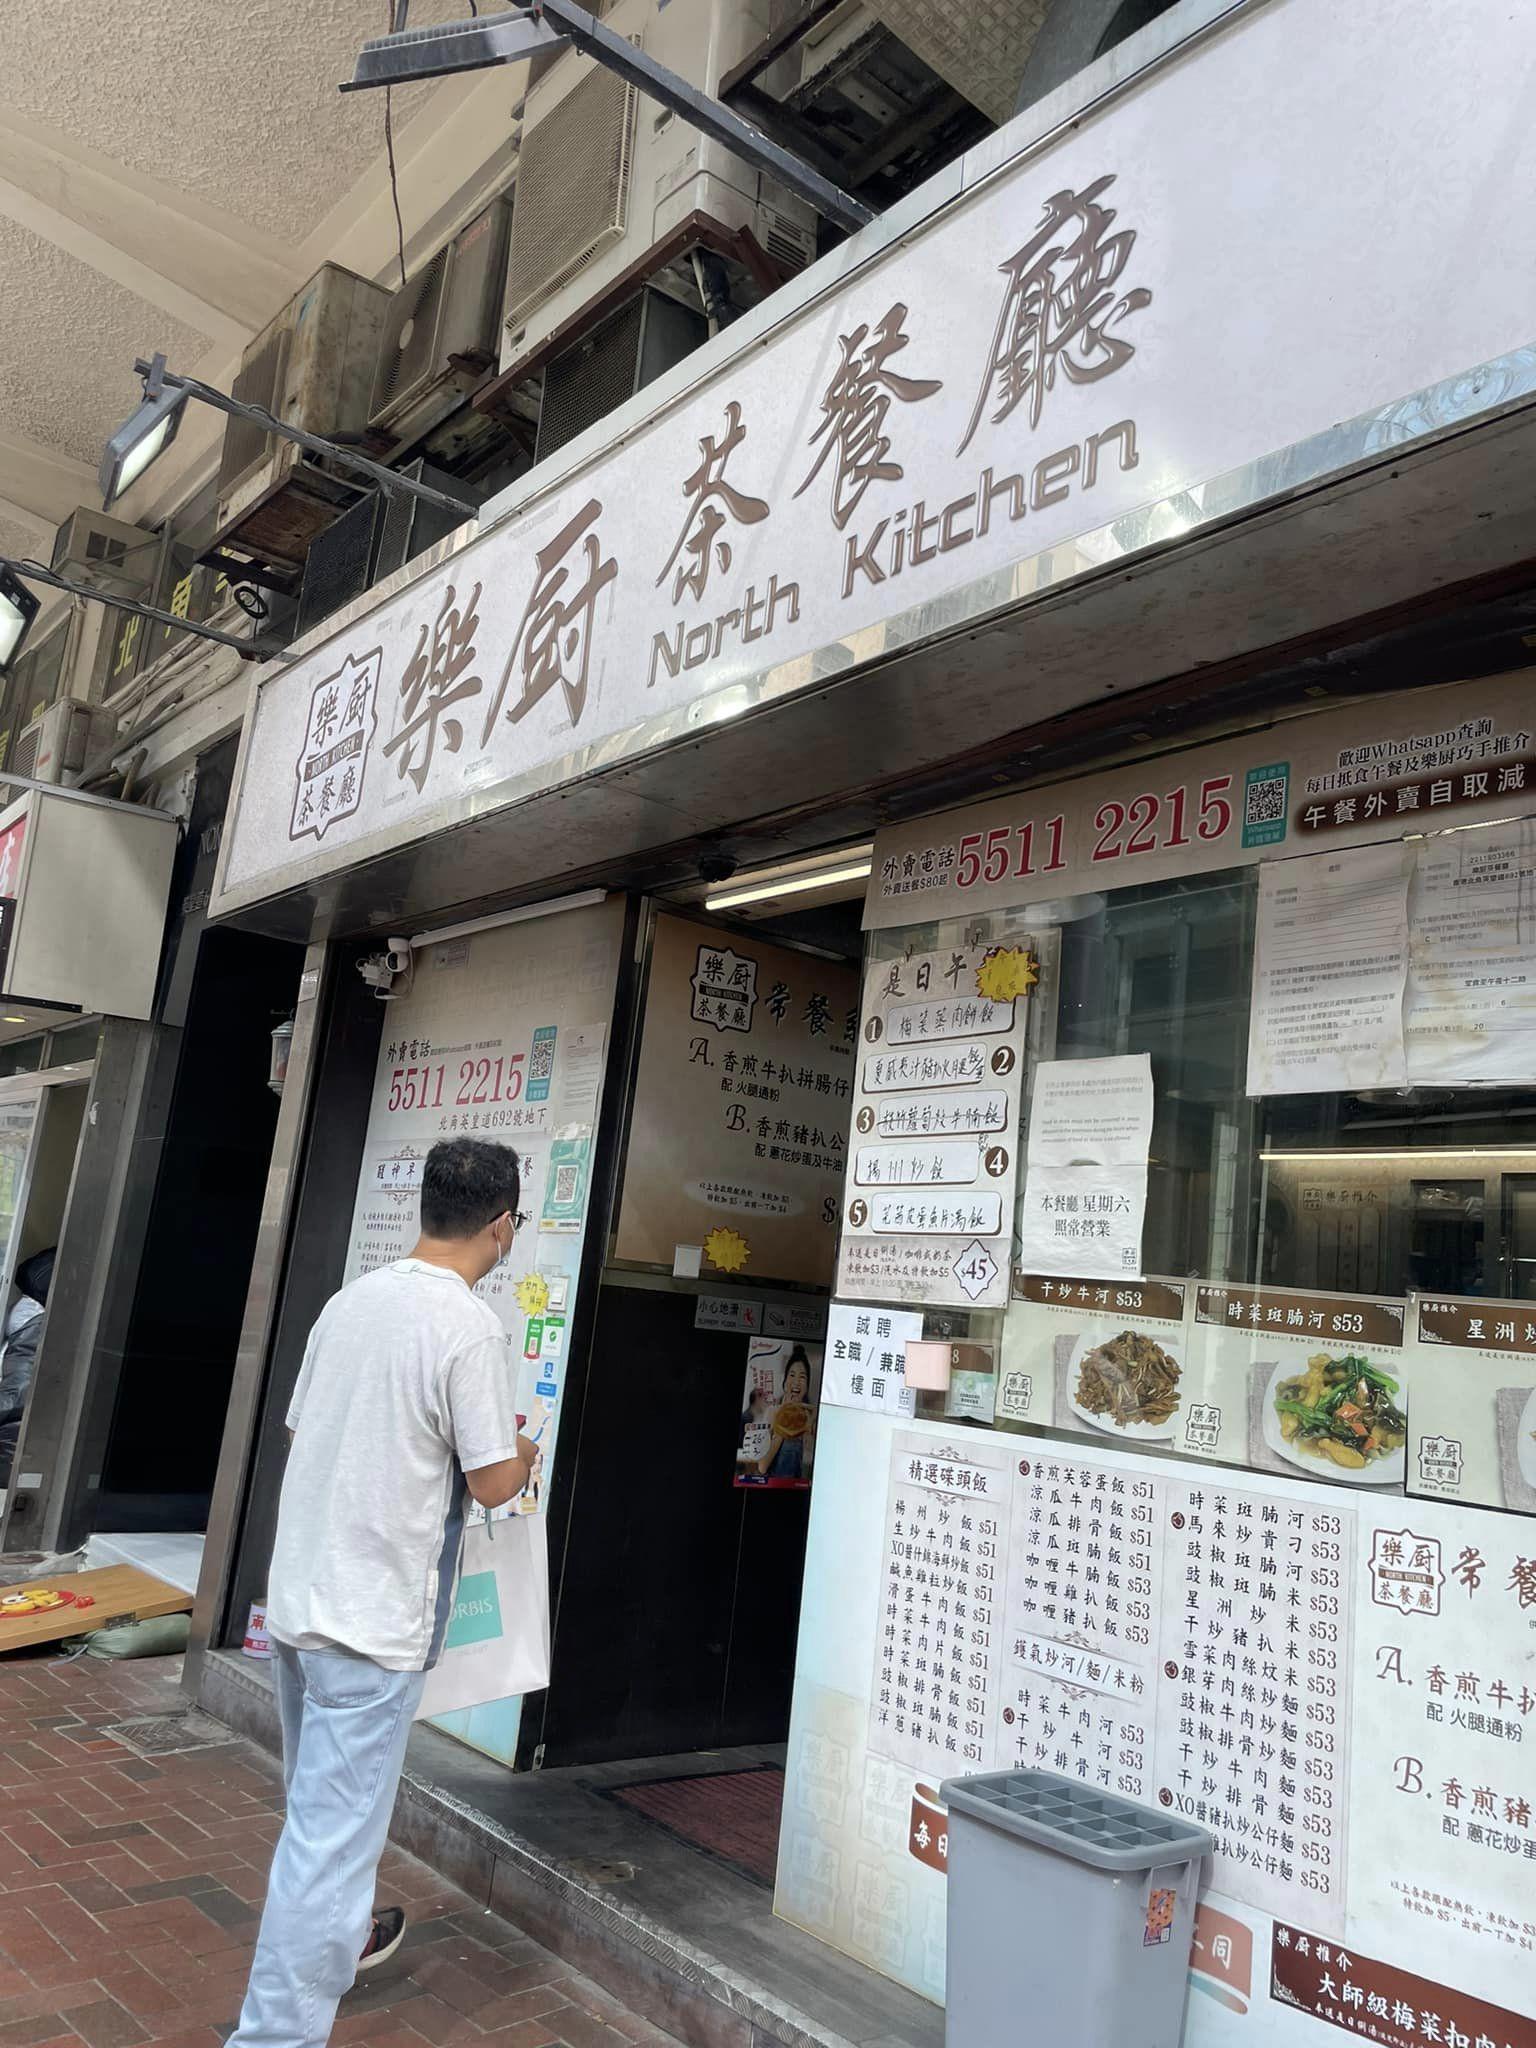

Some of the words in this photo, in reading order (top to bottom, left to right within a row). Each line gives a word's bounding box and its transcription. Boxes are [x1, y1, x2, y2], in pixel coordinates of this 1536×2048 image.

[648, 574, 800, 688] North
[841, 418, 1140, 600] Kitchen
[1303, 763, 1526, 830] 午餐外賣自取減
[881, 847, 954, 881] 外賣電話
[956, 814, 1068, 888] 5511
[1092, 775, 1233, 863] 2215
[702, 954, 752, 993] 樂厨
[882, 949, 987, 1000] 是日午
[695, 997, 747, 1028] 茶餐廳
[387, 1039, 431, 1063] 外賣電話
[689, 1037, 715, 1067] A.
[388, 1063, 446, 1112] 5511
[455, 1053, 526, 1106] 2215
[725, 1103, 751, 1134] B.
[1041, 1193, 1079, 1213] 本餐廳
[1083, 1193, 1130, 1213] 星期六
[1054, 1218, 1112, 1238] 照常營業
[961, 1257, 989, 1281] $45
[1041, 1281, 1110, 1306] 干炒牛河
[1116, 1290, 1142, 1309] $53
[856, 1315, 892, 1339] 誠聘
[1227, 1301, 1327, 1331] 時菜斑腩河
[1332, 1313, 1364, 1336] $53
[850, 1373, 886, 1400] 樓面
[908, 1459, 988, 1493] 精選碟頭飯
[1033, 1462, 1125, 1495] 香煎芙蓉蛋飯
[1132, 1481, 1155, 1500] $51
[1030, 1484, 1124, 1518] 涼瓜牛肉飯
[1131, 1505, 1154, 1524] $51
[1189, 1491, 1305, 1530] 時菜斑腩河
[1312, 1514, 1341, 1536] $53
[893, 1520, 971, 1553] 生炒牛肉飯
[977, 1541, 996, 1559] $51
[979, 1519, 997, 1537] $51
[1029, 1506, 1123, 1542] 涼瓜排骨飯
[1130, 1528, 1153, 1548] $51
[1188, 1514, 1302, 1554] 馬來炒貴刁
[1311, 1541, 1340, 1562] $53
[1028, 1528, 1122, 1566] 涼瓜斑腩飯
[1129, 1552, 1152, 1572] $51
[1186, 1541, 1304, 1582] 豉椒斑腩河
[1310, 1567, 1340, 1589] $53
[1379, 1537, 1435, 1574] 樂厨
[976, 1563, 995, 1581] $51
[1127, 1576, 1152, 1596] $53
[1185, 1565, 1301, 1607] 豉椒斑腩米
[1309, 1594, 1339, 1616] $53
[888, 1581, 967, 1618] 滑蛋牛肉飯
[972, 1607, 992, 1626] $51
[974, 1585, 993, 1603] $51
[1126, 1600, 1151, 1620] $53
[1378, 1581, 1434, 1611] 茶餐廳
[886, 1602, 965, 1641] 時菜牛肉飯
[971, 1630, 991, 1648] $51
[1125, 1625, 1149, 1646] $53
[1185, 1590, 1301, 1634] 星洲炒米
[1308, 1621, 1338, 1643] $53
[885, 1623, 964, 1663] 時菜肉片飯
[969, 1652, 988, 1671] $51
[1308, 1648, 1337, 1670] $53
[1375, 1645, 1413, 1687] A.
[883, 1645, 962, 1685] 時菜斑腩飯
[968, 1674, 987, 1693] $51
[1183, 1639, 1299, 1687] 雪菜肉絲炆米
[1307, 1674, 1336, 1698] $53
[881, 1666, 961, 1707] 豉椒排骨飯
[966, 1697, 986, 1716] $51
[879, 1688, 959, 1731] 豉椒斑腩飯
[964, 1720, 985, 1740] $51
[1018, 1688, 1114, 1736] 時菜牛肉河
[1120, 1724, 1144, 1745] $53
[1180, 1691, 1299, 1743] 豉椒牛肉炒麵
[1305, 1730, 1335, 1754] $53
[1306, 1702, 1336, 1726] $53
[1426, 1701, 1444, 1723] 配
[1450, 1707, 1523, 1743] 火腿通粉
[963, 1743, 983, 1763] $51
[1016, 1712, 1113, 1761] 干炒牛河
[1119, 1749, 1143, 1771] $53
[1178, 1717, 1298, 1770] 豉椒排骨炒麵
[1304, 1757, 1334, 1782] $53
[1015, 1736, 1112, 1787] 干炒排骨河
[1118, 1773, 1142, 1797] $53
[1178, 1742, 1297, 1798] 干炒牛肉麵
[1303, 1786, 1333, 1810] $53
[1177, 1768, 1296, 1826] 干炒排骨麵
[1302, 1814, 1332, 1838] $53
[1393, 1755, 1432, 1800] B.
[1440, 1776, 1536, 1829] 香煎豬
[1442, 1814, 1460, 1838] 配
[1301, 1842, 1331, 1866] $53
[1300, 1870, 1330, 1895] $53
[1276, 1927, 1353, 1973] 樂厨推介
